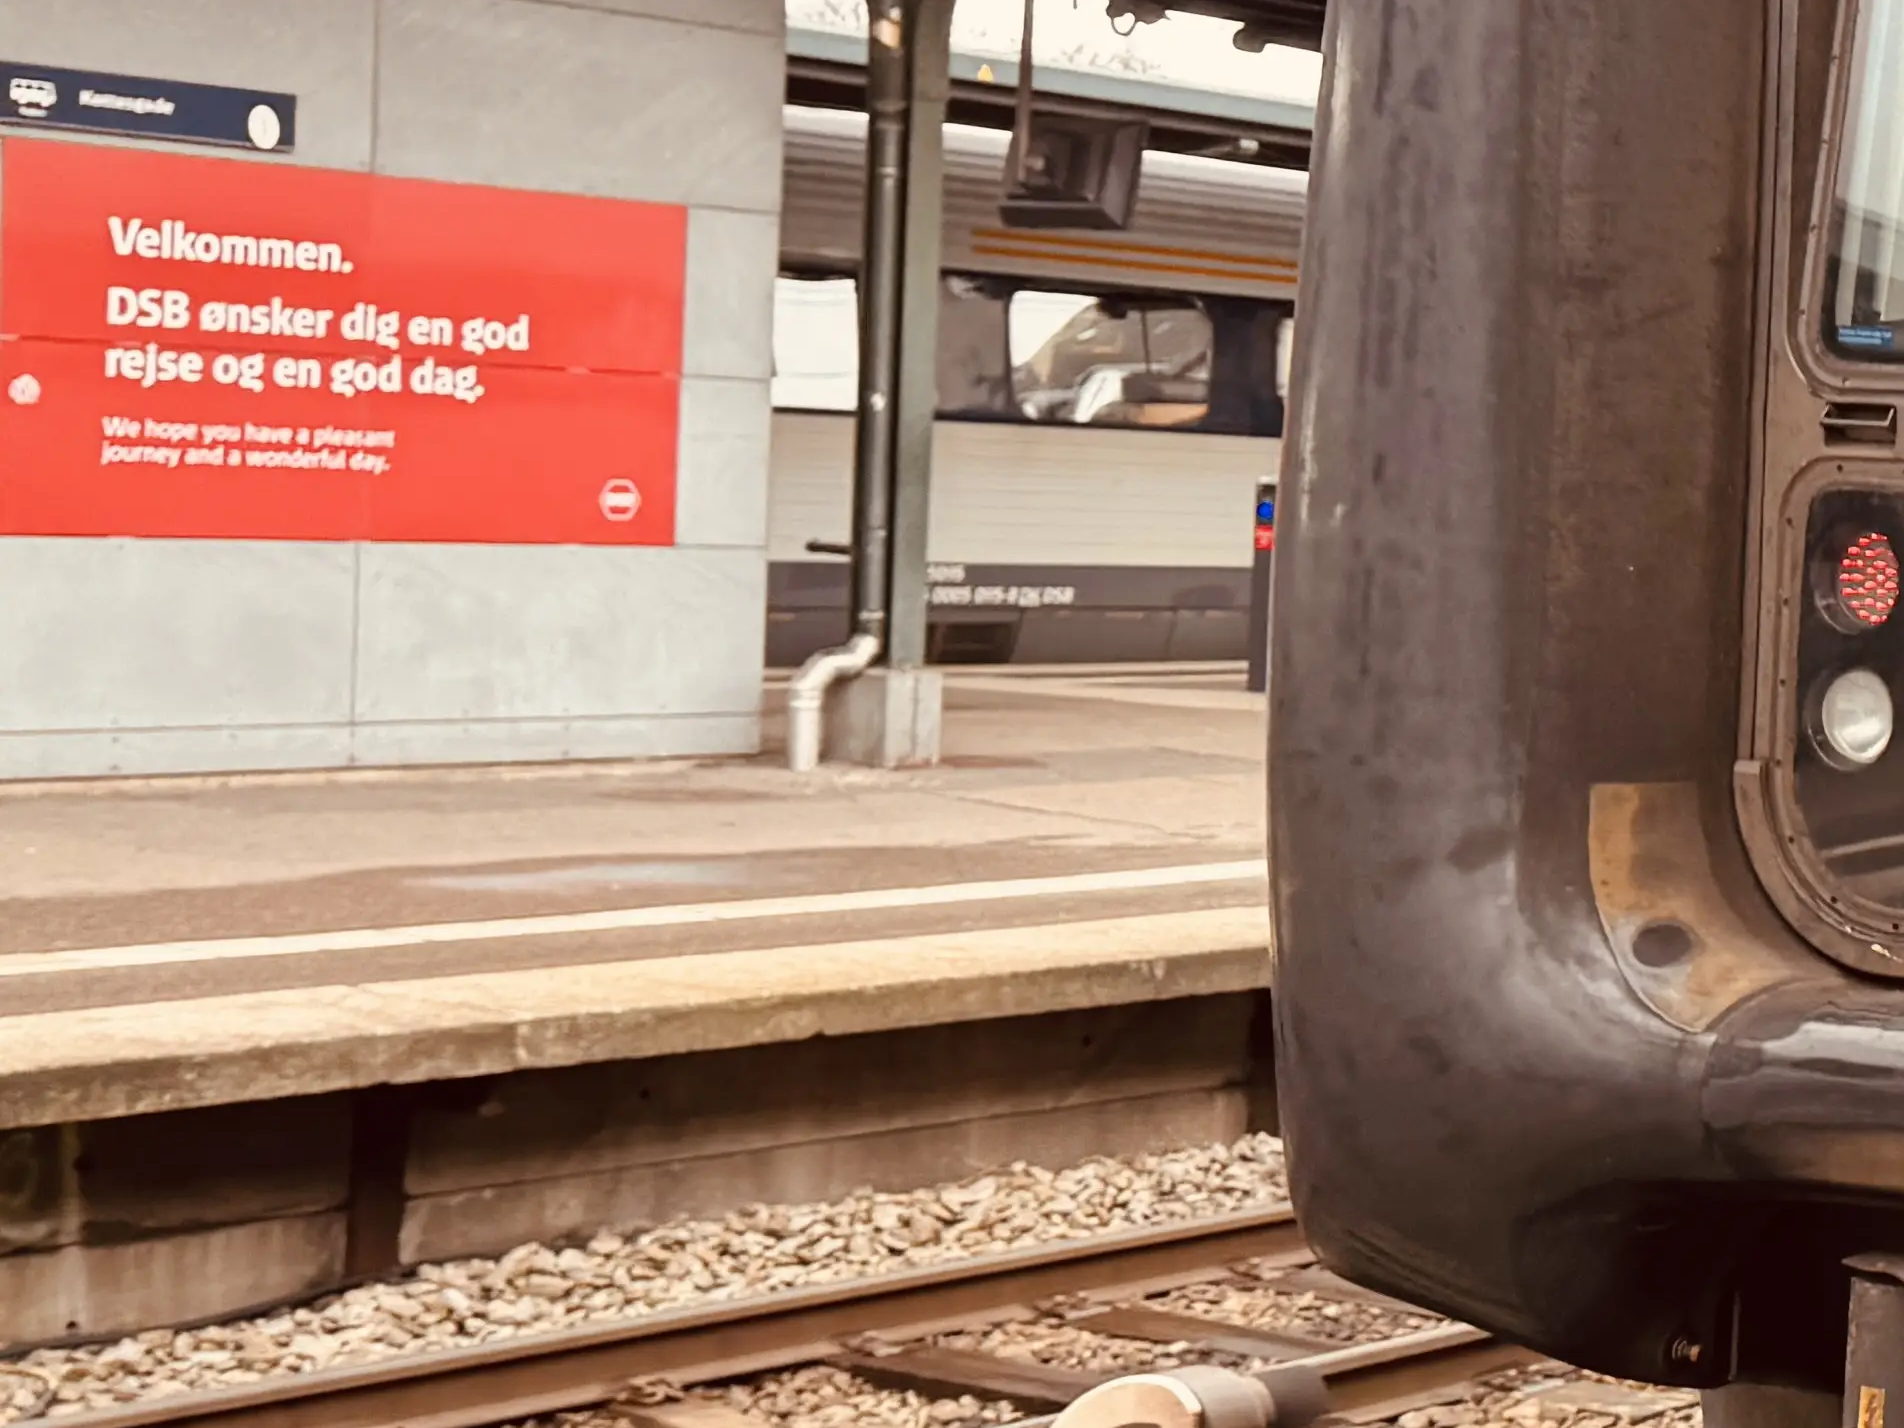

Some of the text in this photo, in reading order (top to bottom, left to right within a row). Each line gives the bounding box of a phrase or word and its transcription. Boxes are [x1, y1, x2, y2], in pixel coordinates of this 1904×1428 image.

[108, 215, 354, 274] Velkommen.
[106, 286, 530, 355] DSB ønsker dig en god
[104, 342, 485, 403] rejse og en god dag.
[100, 440, 182, 468] journey
[184, 444, 224, 466] and
[101, 416, 142, 439] We
[144, 417, 198, 443] hope
[201, 424, 241, 445] you
[244, 422, 293, 444] have
